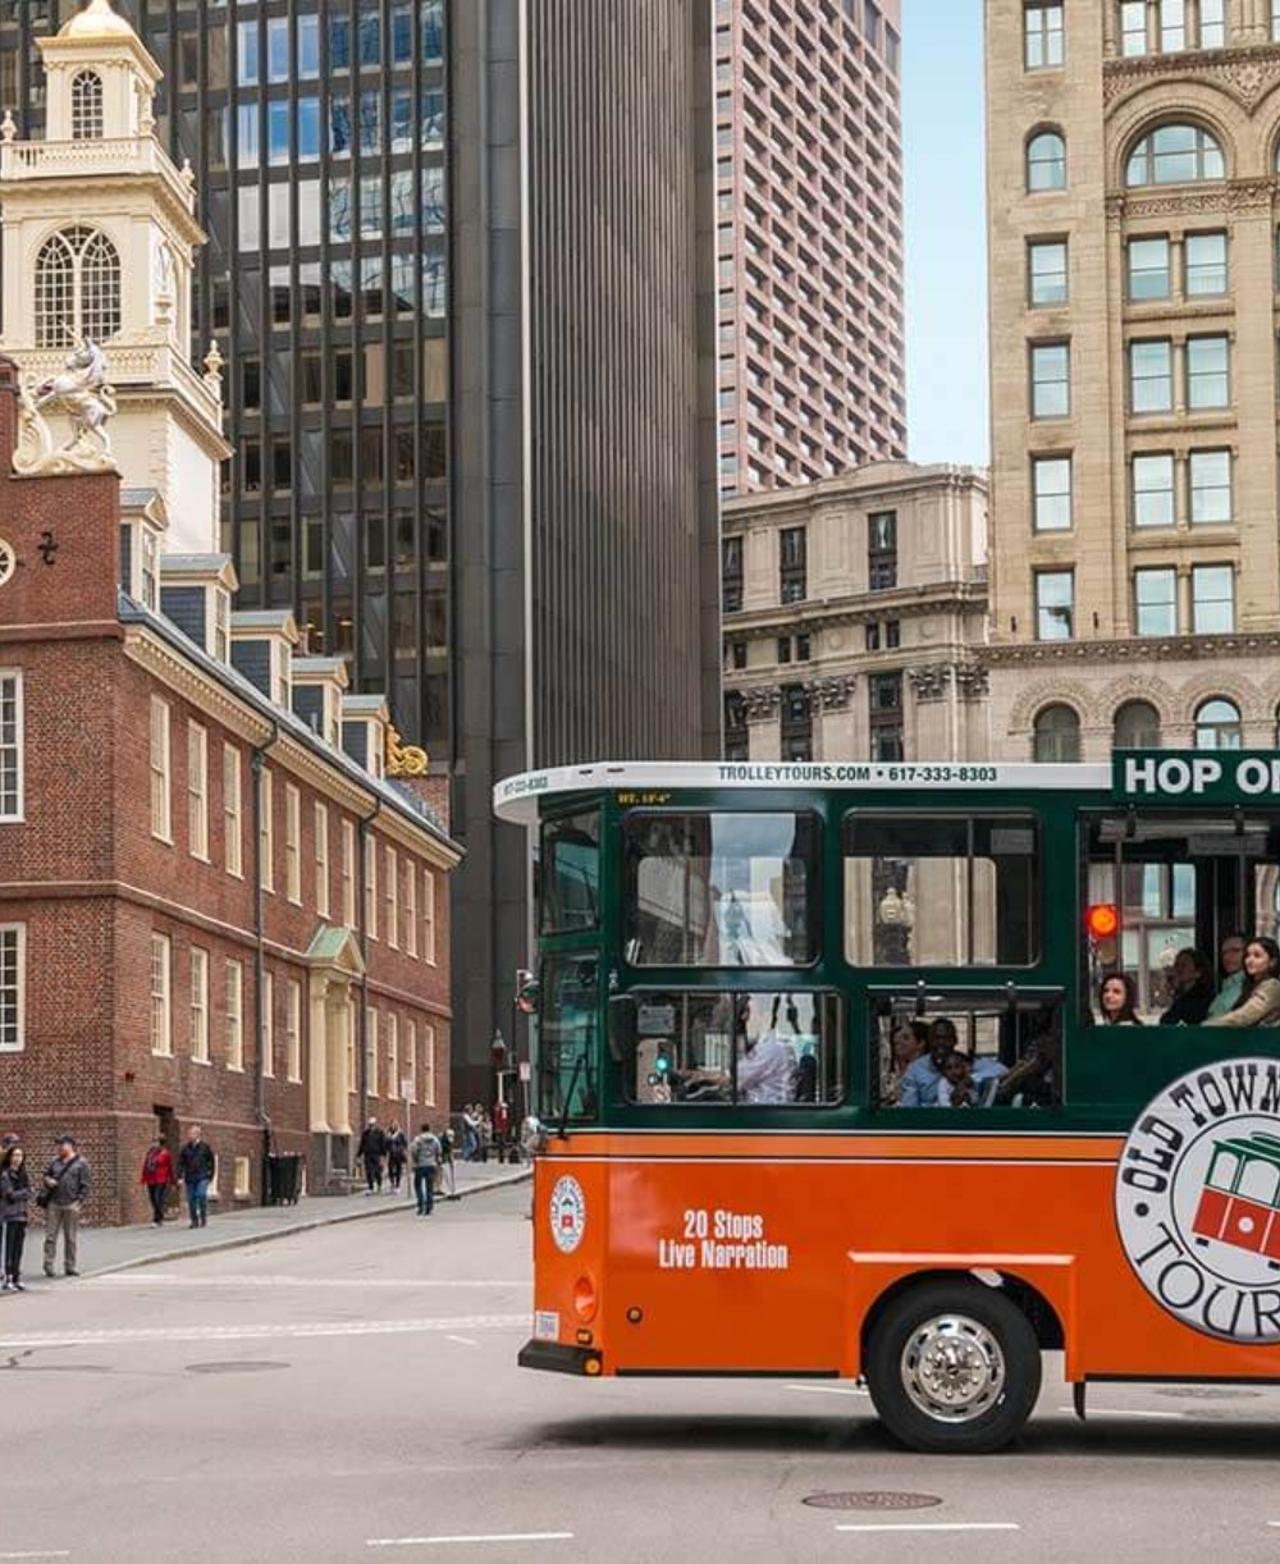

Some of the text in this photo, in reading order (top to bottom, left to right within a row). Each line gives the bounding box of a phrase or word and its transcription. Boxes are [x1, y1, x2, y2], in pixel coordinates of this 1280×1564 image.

[719, 766, 997, 781] TROLLEYTOURS.COM 617-333-8303
[1125, 758, 1220, 794] HOP
[1122, 1115, 1184, 1193] OLD
[683, 1210, 763, 1242] 20 Stops
[658, 1239, 789, 1269] Live Narration
